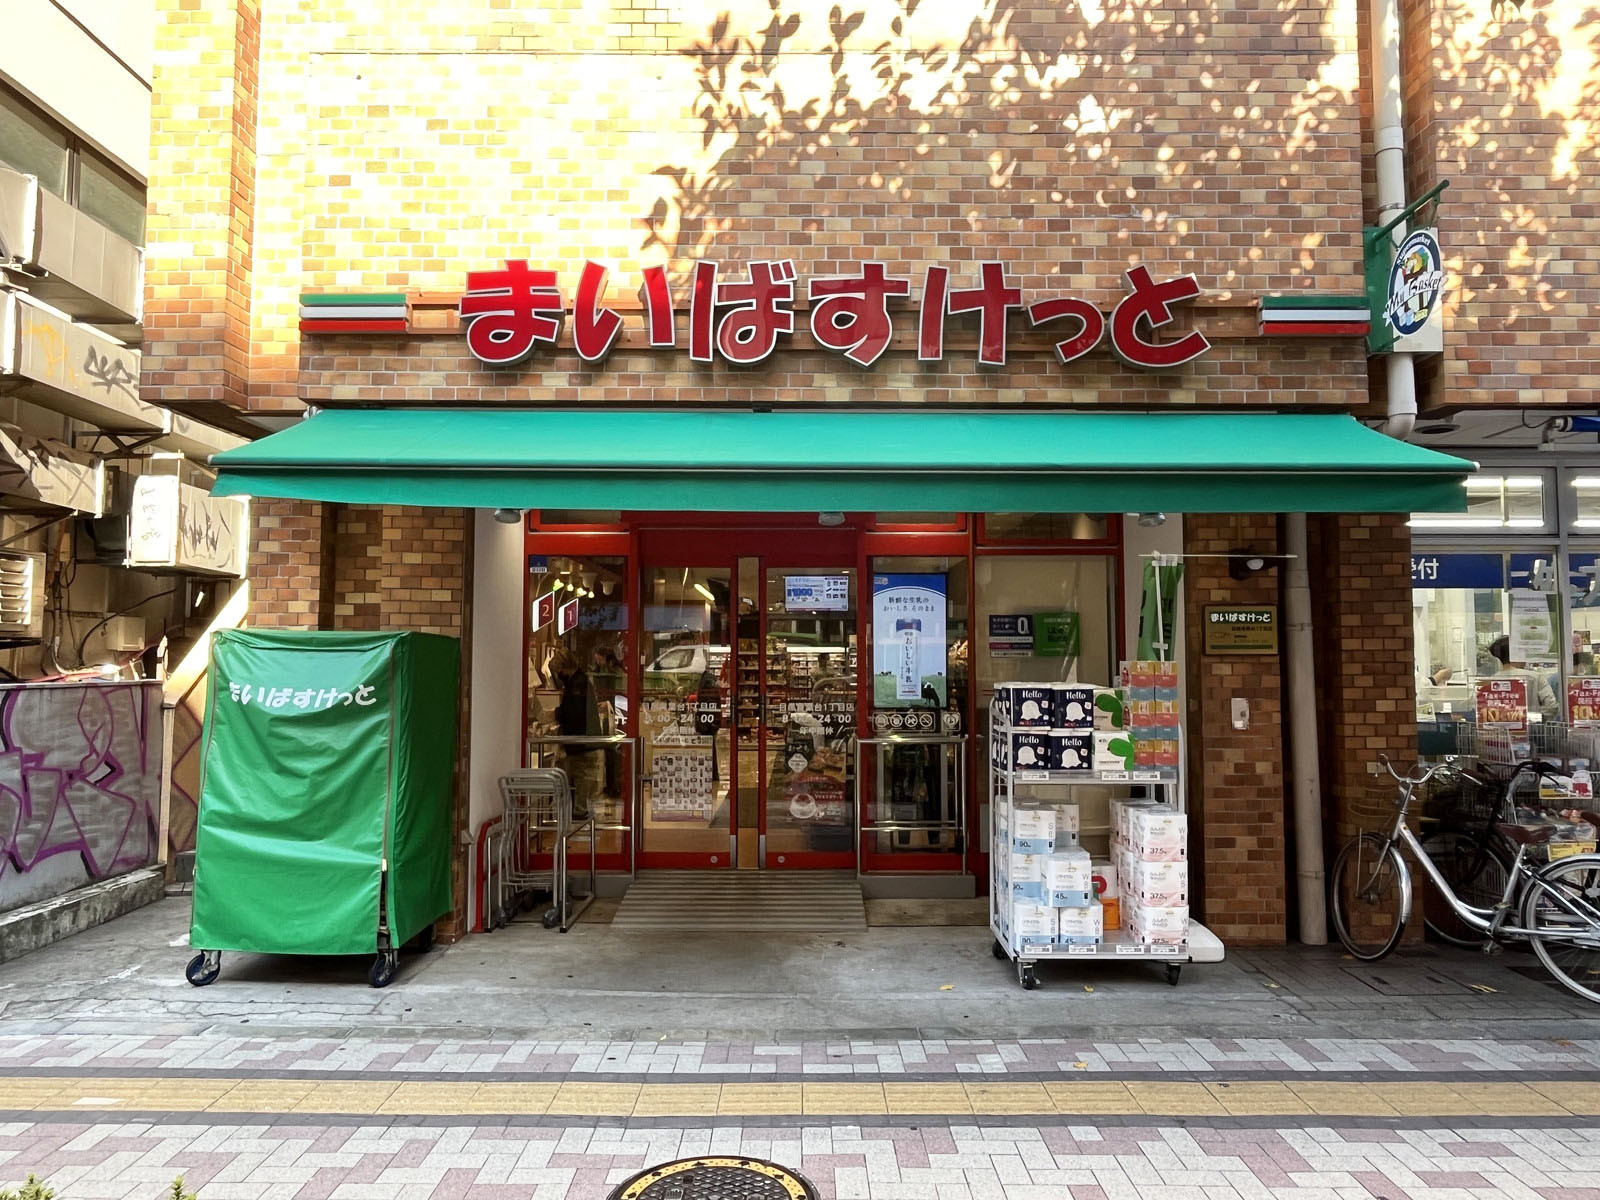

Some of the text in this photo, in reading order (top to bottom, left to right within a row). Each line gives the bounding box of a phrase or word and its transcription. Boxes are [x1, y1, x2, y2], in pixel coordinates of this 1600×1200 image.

[1408, 270, 1441, 298] Basket
[459, 258, 1211, 368] まいばすけっと
[542, 604, 550, 617] 2
[567, 610, 573, 622] 1
[1210, 613, 1271, 622] まいばすけっと
[1022, 690, 1042, 698] Hello
[1066, 691, 1086, 700] Hello
[1019, 735, 1039, 744] Hello
[1061, 738, 1082, 746] Hello
